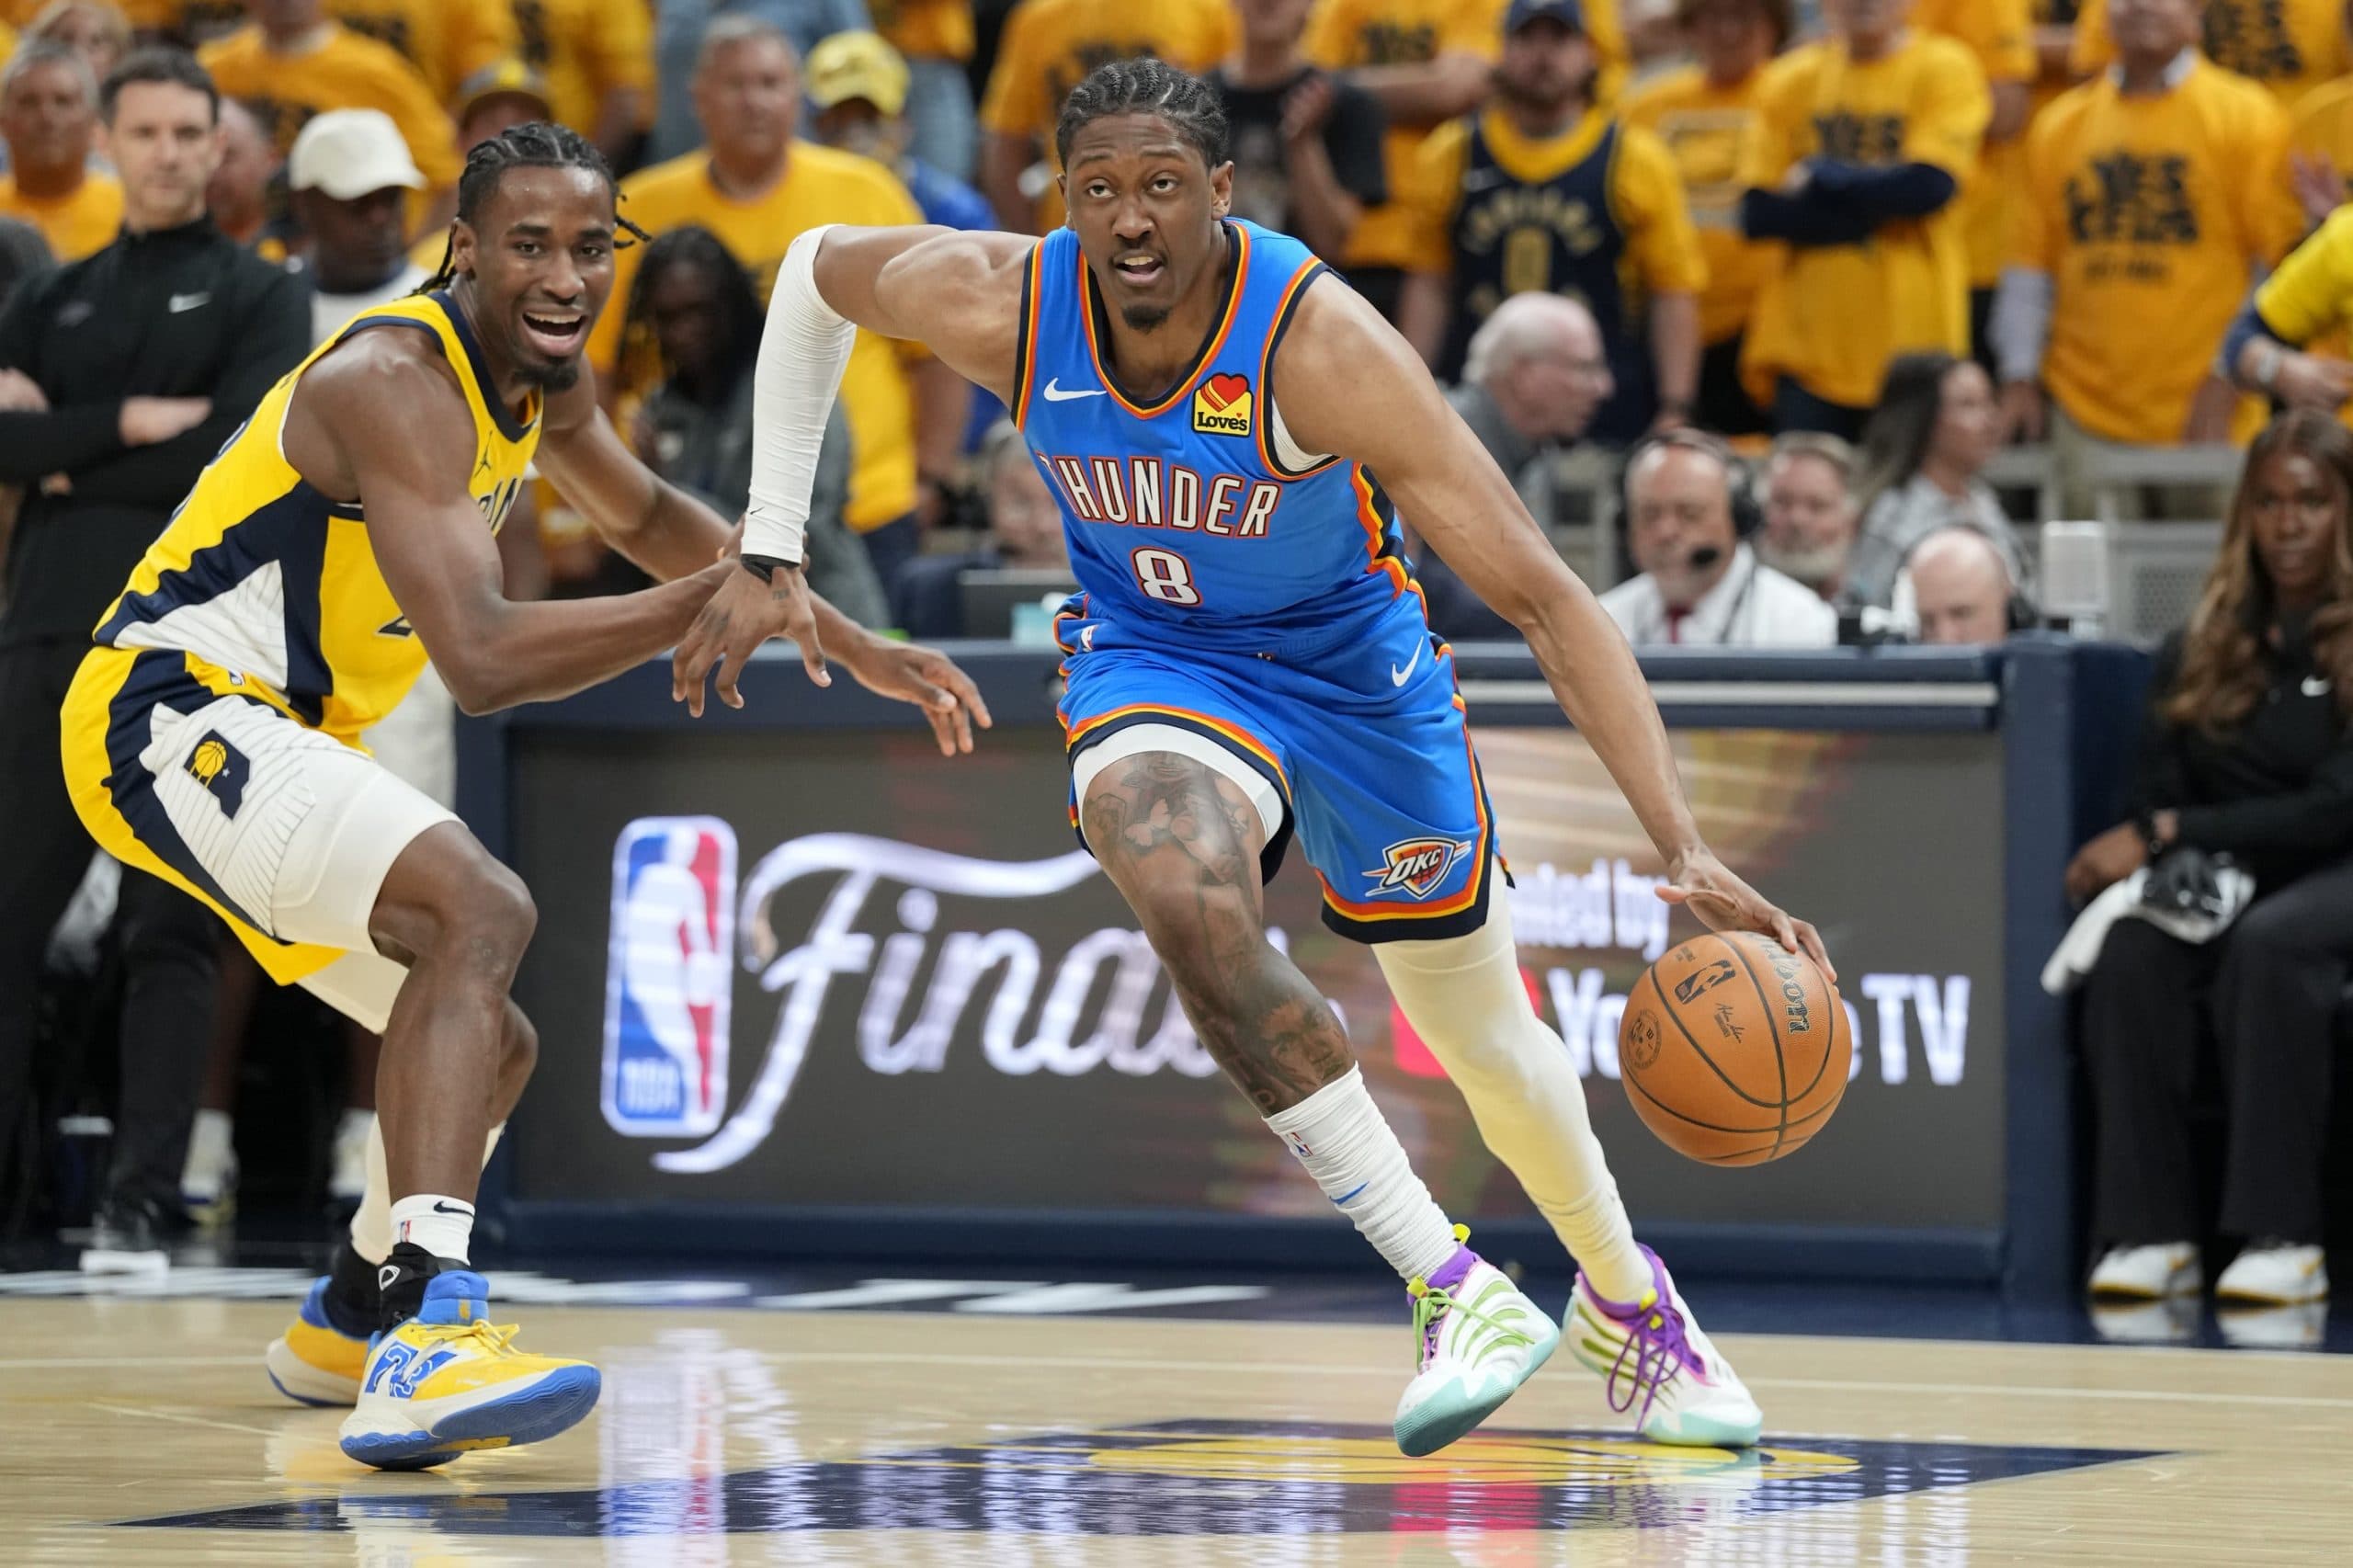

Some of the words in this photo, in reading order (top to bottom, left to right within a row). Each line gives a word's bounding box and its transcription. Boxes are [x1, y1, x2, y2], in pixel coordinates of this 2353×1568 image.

[1131, 546, 1202, 608] 8
[1382, 847, 1442, 887] OKC
[651, 831, 1344, 1174] Fina
[1859, 971, 1972, 1086] TV
